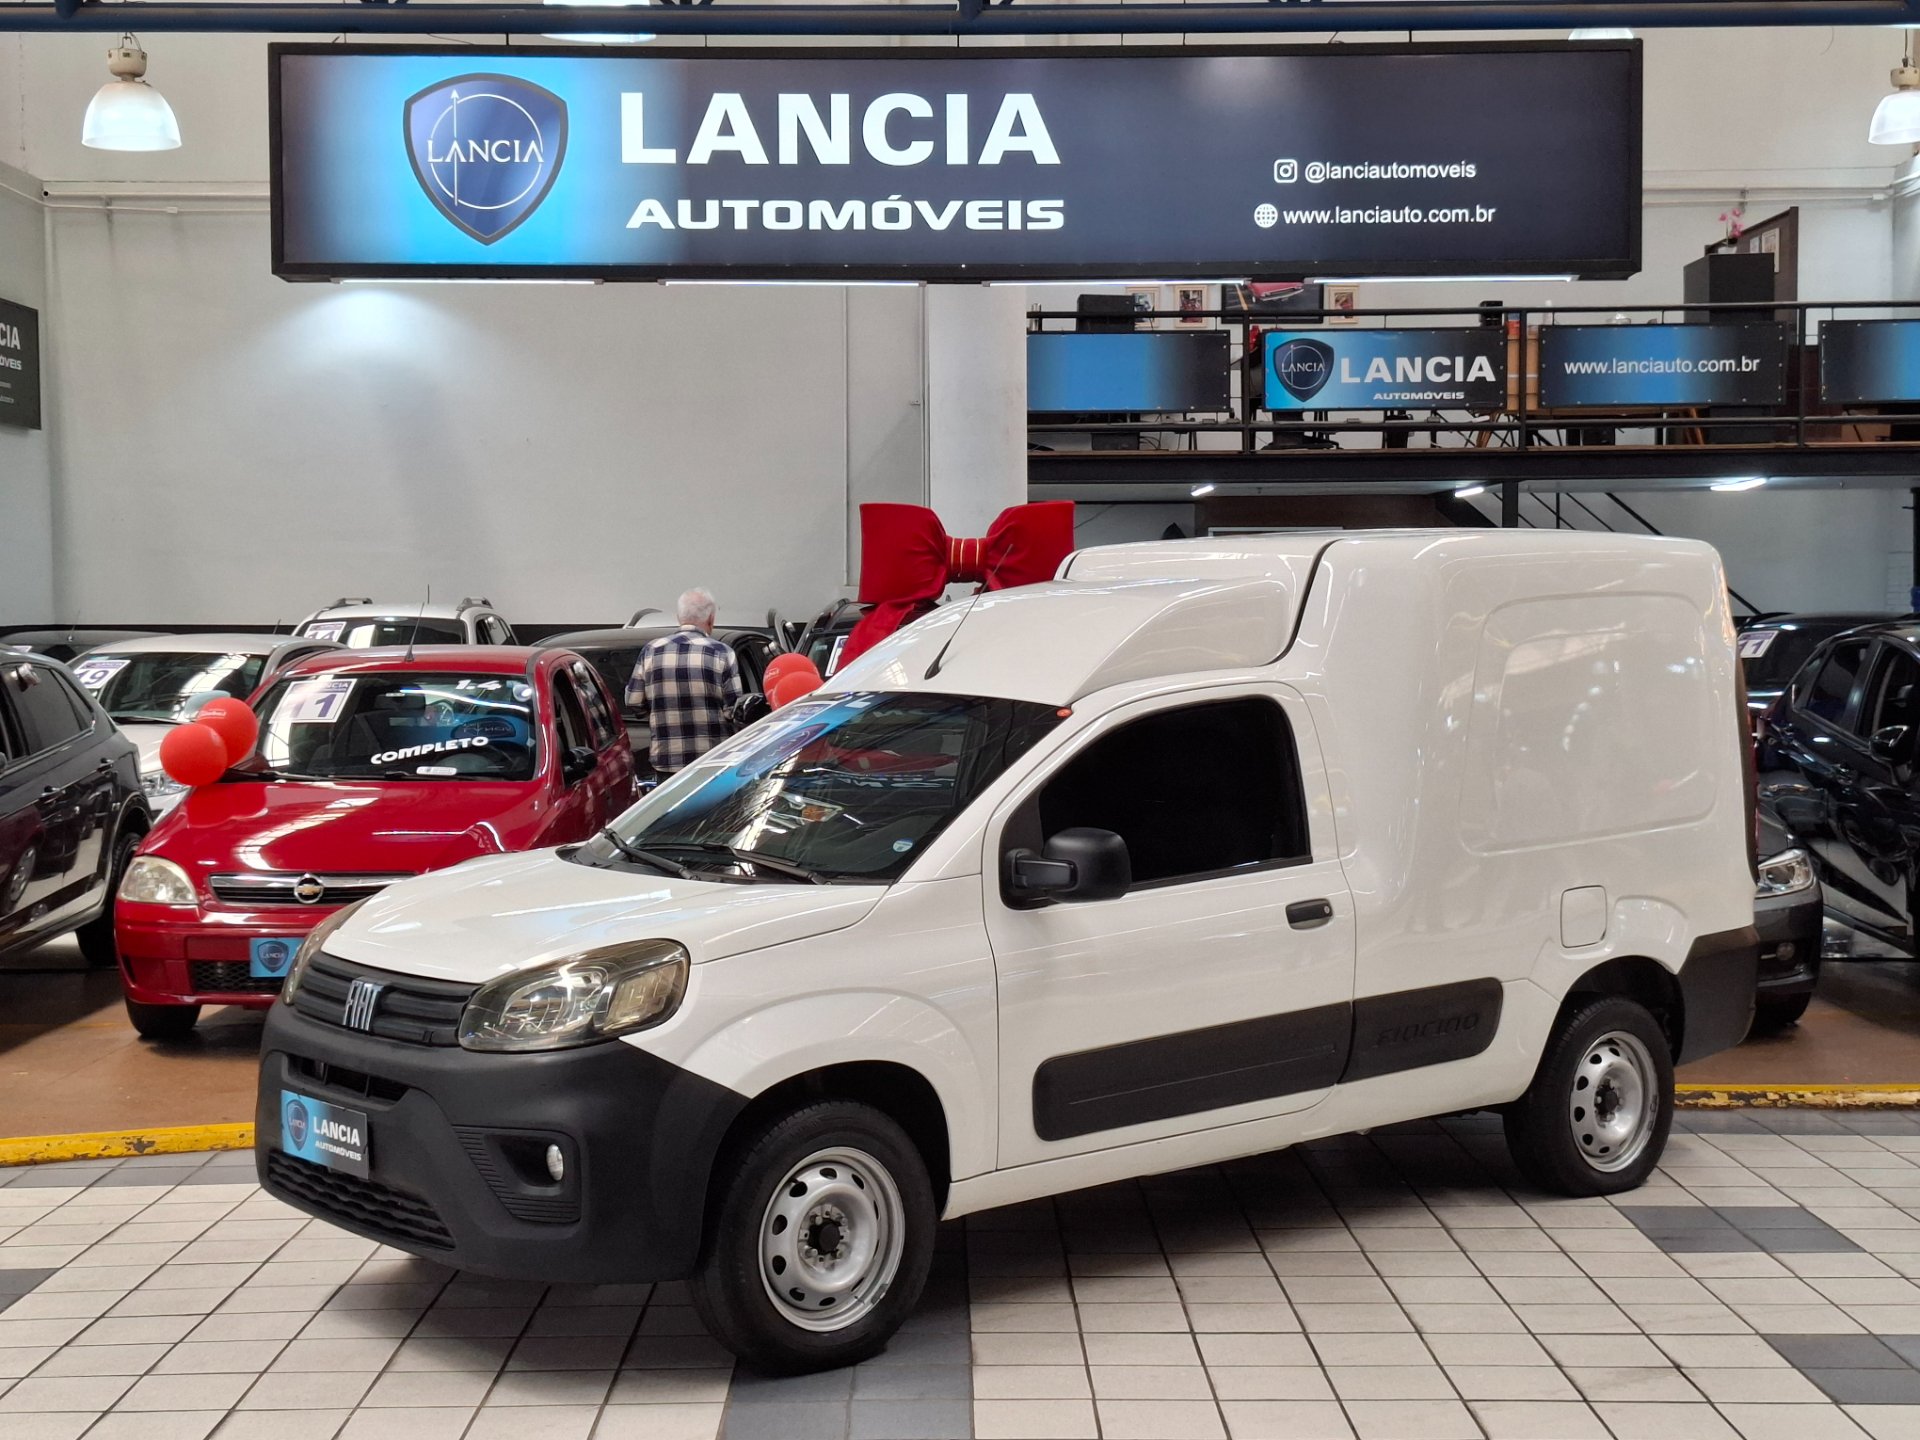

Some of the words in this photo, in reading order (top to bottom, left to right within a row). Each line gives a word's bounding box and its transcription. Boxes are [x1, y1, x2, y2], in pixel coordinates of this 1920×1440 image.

[621, 91, 1062, 166] LANCIA
[427, 139, 544, 163] LANCIA
[1305, 161, 1477, 183] @lanciautomoveis
[625, 194, 1065, 231] AUTOMÓVEIS
[1283, 205, 1496, 224] www.lanciauto.com.br
[1281, 362, 1325, 373] LANCIA
[1341, 355, 1496, 383] LANCIA
[1564, 356, 1760, 374] www.lanciauto.com.br
[1373, 391, 1465, 400] AUTOMÓVEIS
[370, 736, 489, 765] COMPLETO
[342, 980, 384, 1031] FIAT
[313, 1116, 361, 1147] LANCIA
[315, 1140, 362, 1161] AUTOMÓVEIS
